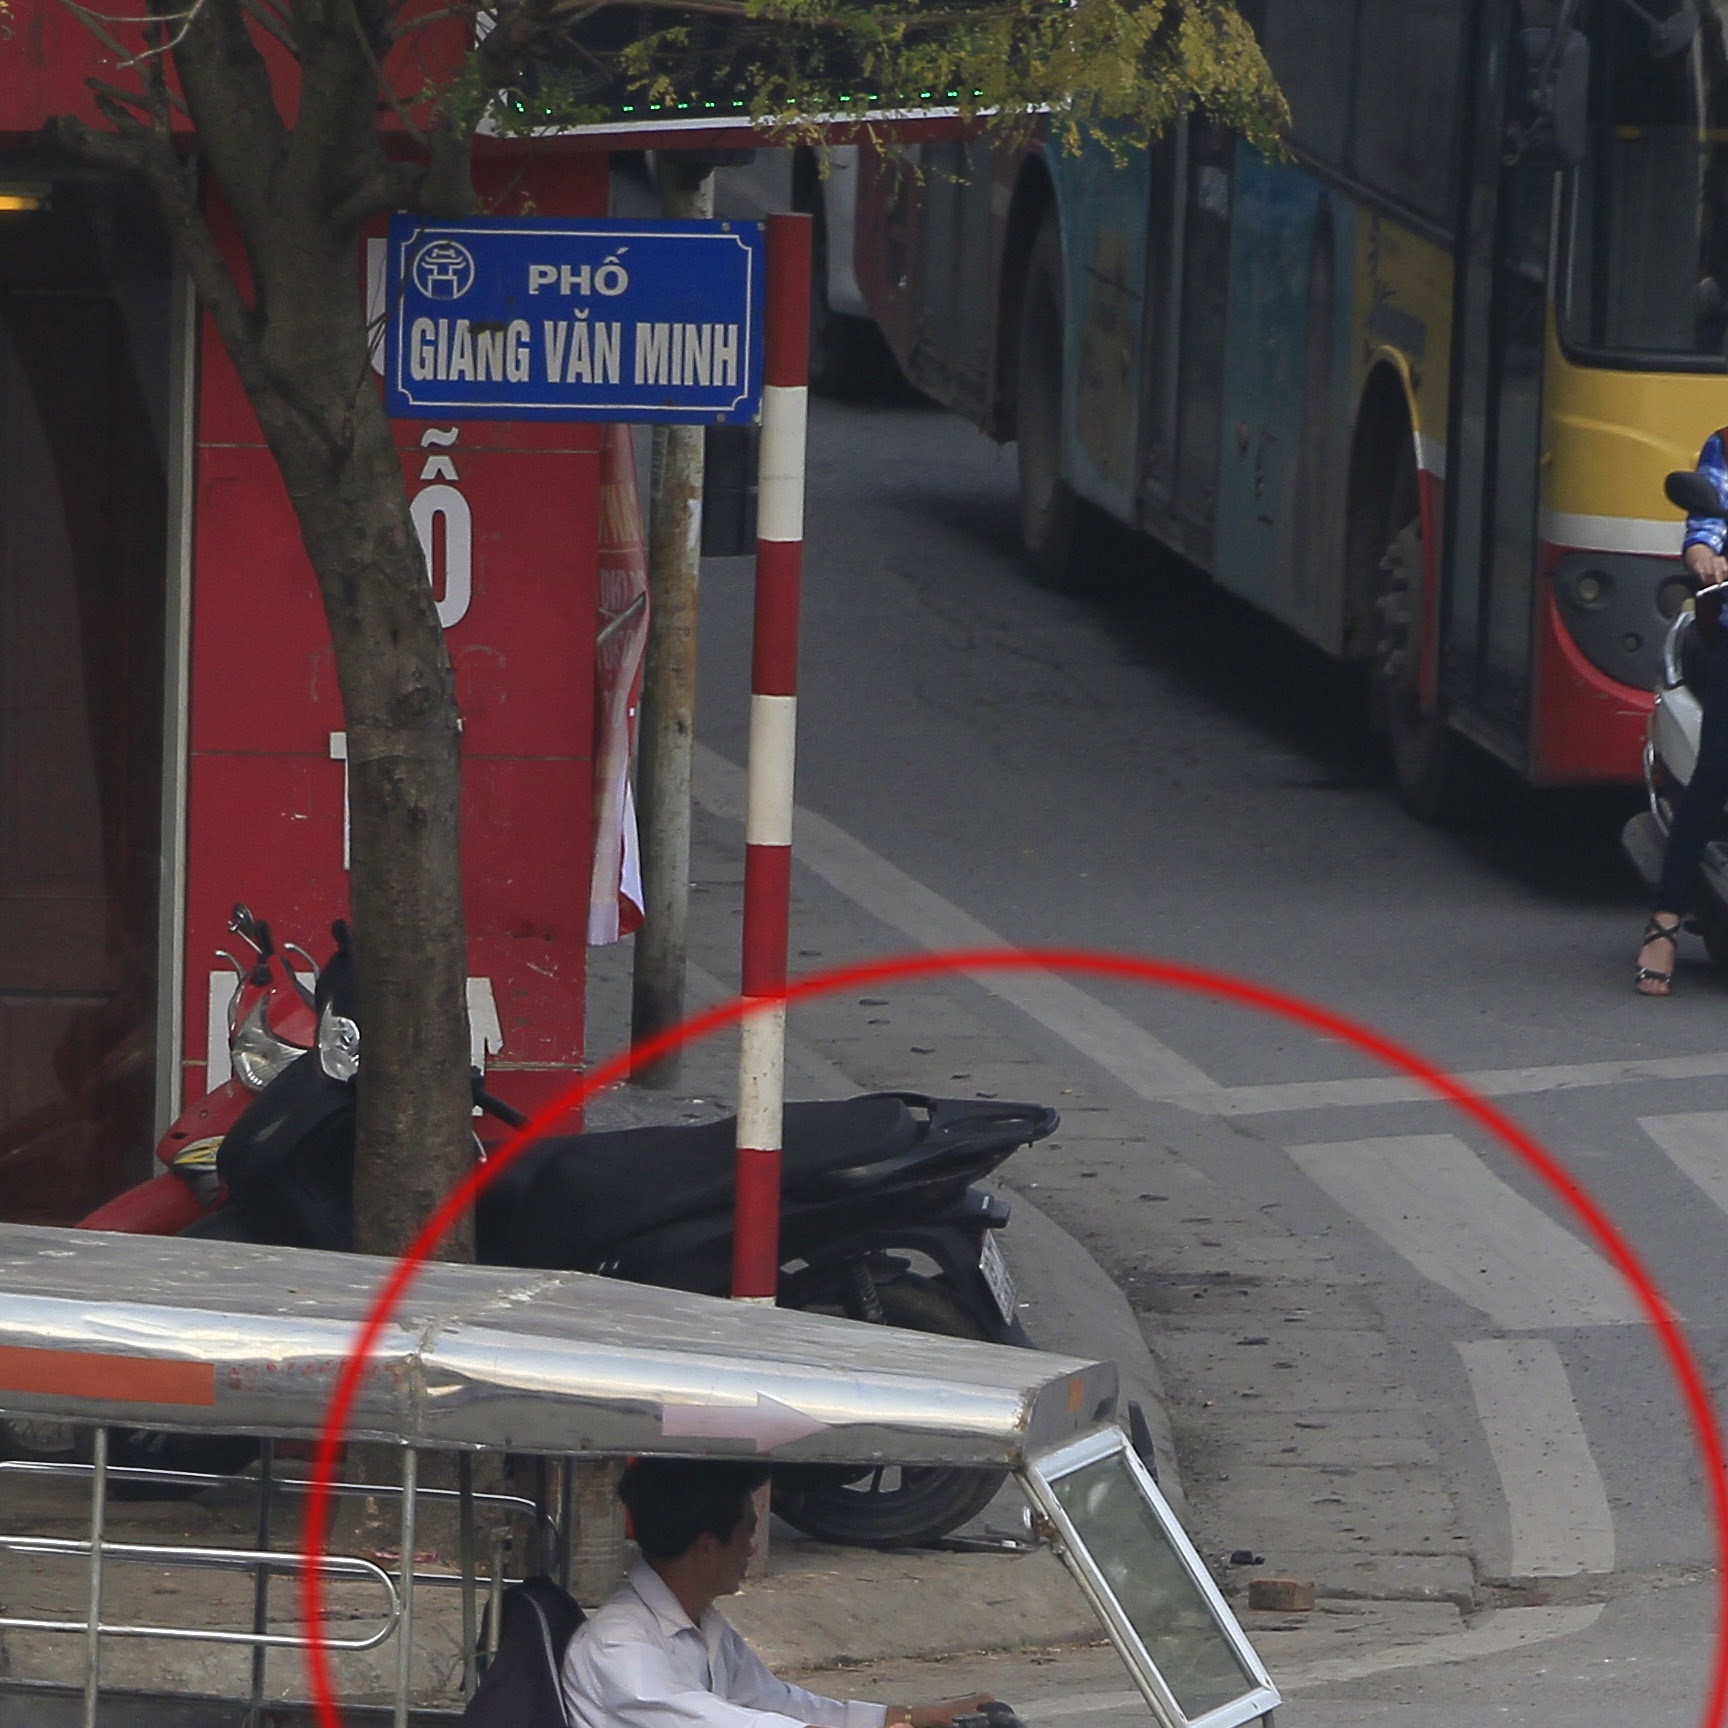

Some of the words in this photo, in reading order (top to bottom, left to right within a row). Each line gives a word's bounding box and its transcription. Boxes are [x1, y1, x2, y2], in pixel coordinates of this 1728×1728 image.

[528, 247, 630, 297] PHỐ
[410, 316, 532, 383] GIANG
[543, 307, 623, 385] VĂN
[634, 322, 740, 387] MINH
